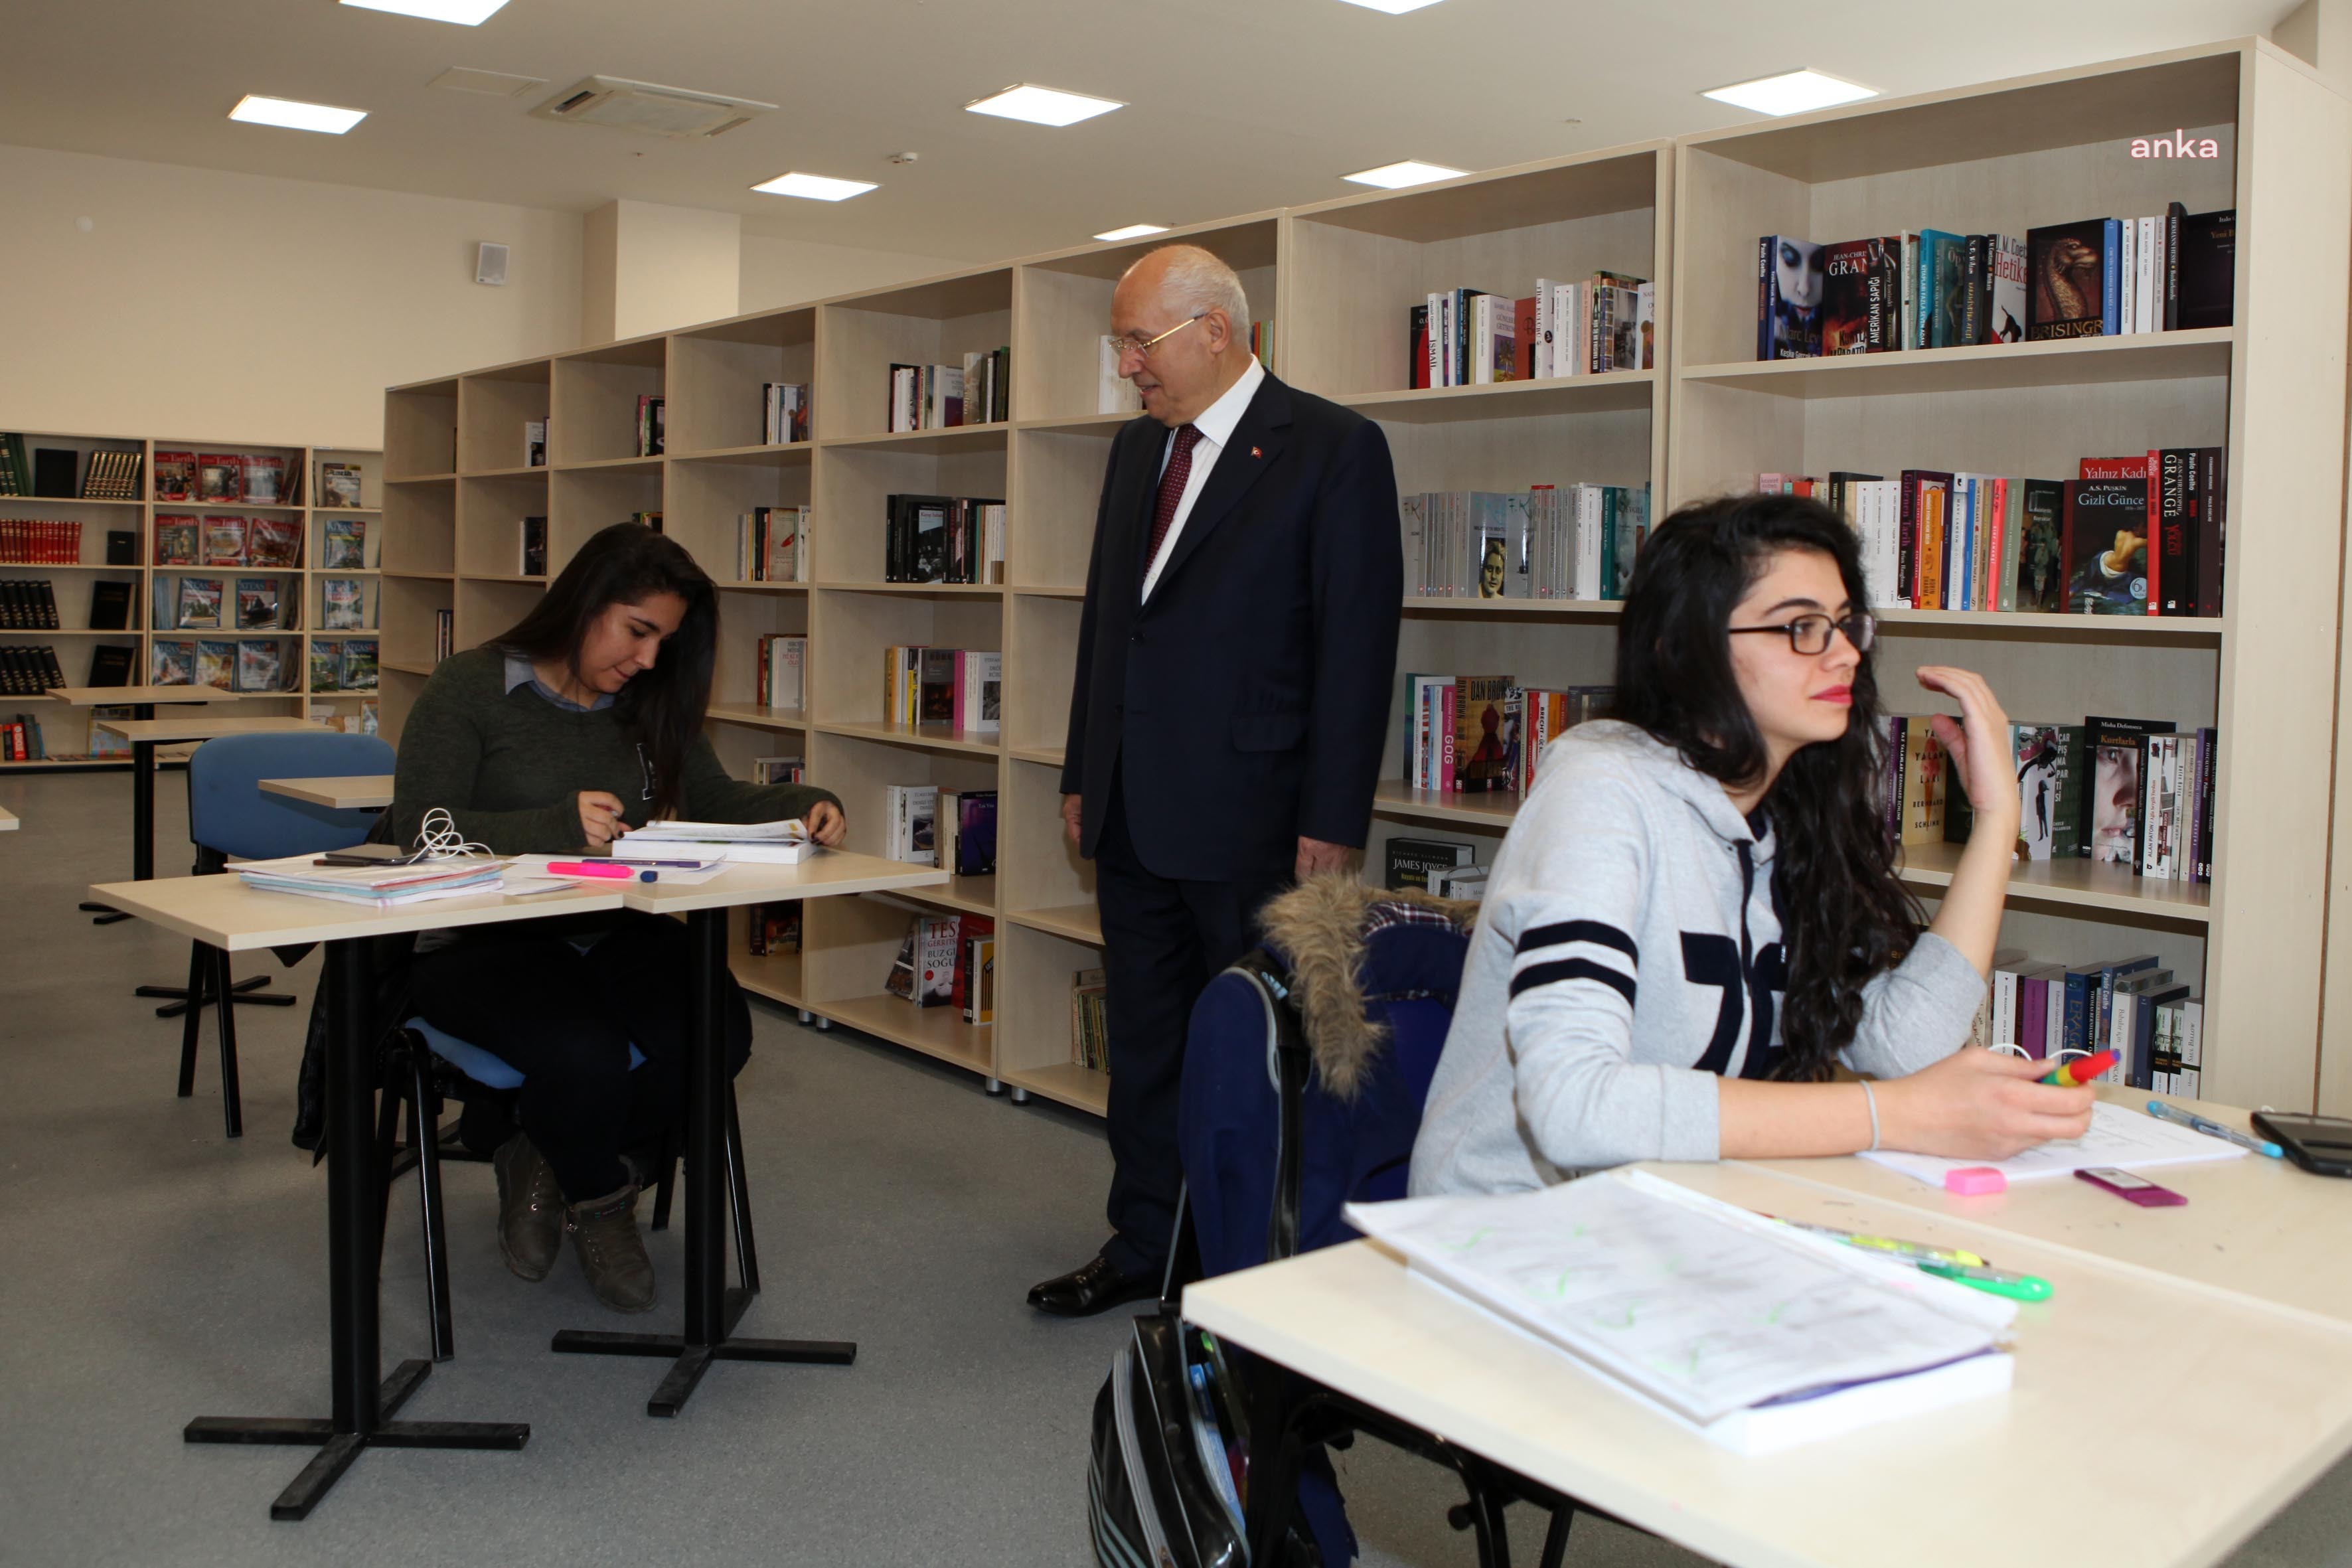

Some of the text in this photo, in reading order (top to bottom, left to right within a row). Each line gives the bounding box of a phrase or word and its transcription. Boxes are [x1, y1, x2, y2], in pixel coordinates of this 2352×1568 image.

[1867, 276, 1880, 344] AMERİKAN SAPIĞI
[2031, 319, 2103, 339] BRISINGR
[2084, 467, 2118, 479] Yalnız
[2163, 455, 2180, 518] GRANGÉ
[2078, 493, 2145, 505] Gizli Günce
[1470, 680, 1486, 701] DAN
[1455, 680, 1466, 719] DAN BROWN
[2058, 734, 2071, 744] ÇAR
[2100, 734, 2136, 745] Kurtlarla
[1444, 735, 1454, 765] GOG
[2057, 757, 2067, 766] MA
[2055, 770, 2069, 779] PAR
[1393, 858, 1448, 874] JAMES JOYCE
[929, 921, 961, 939] TES
[927, 949, 945, 958] BUZ
[2102, 973, 2111, 989] Paulo
[2116, 1008, 2125, 1030] Babalar
